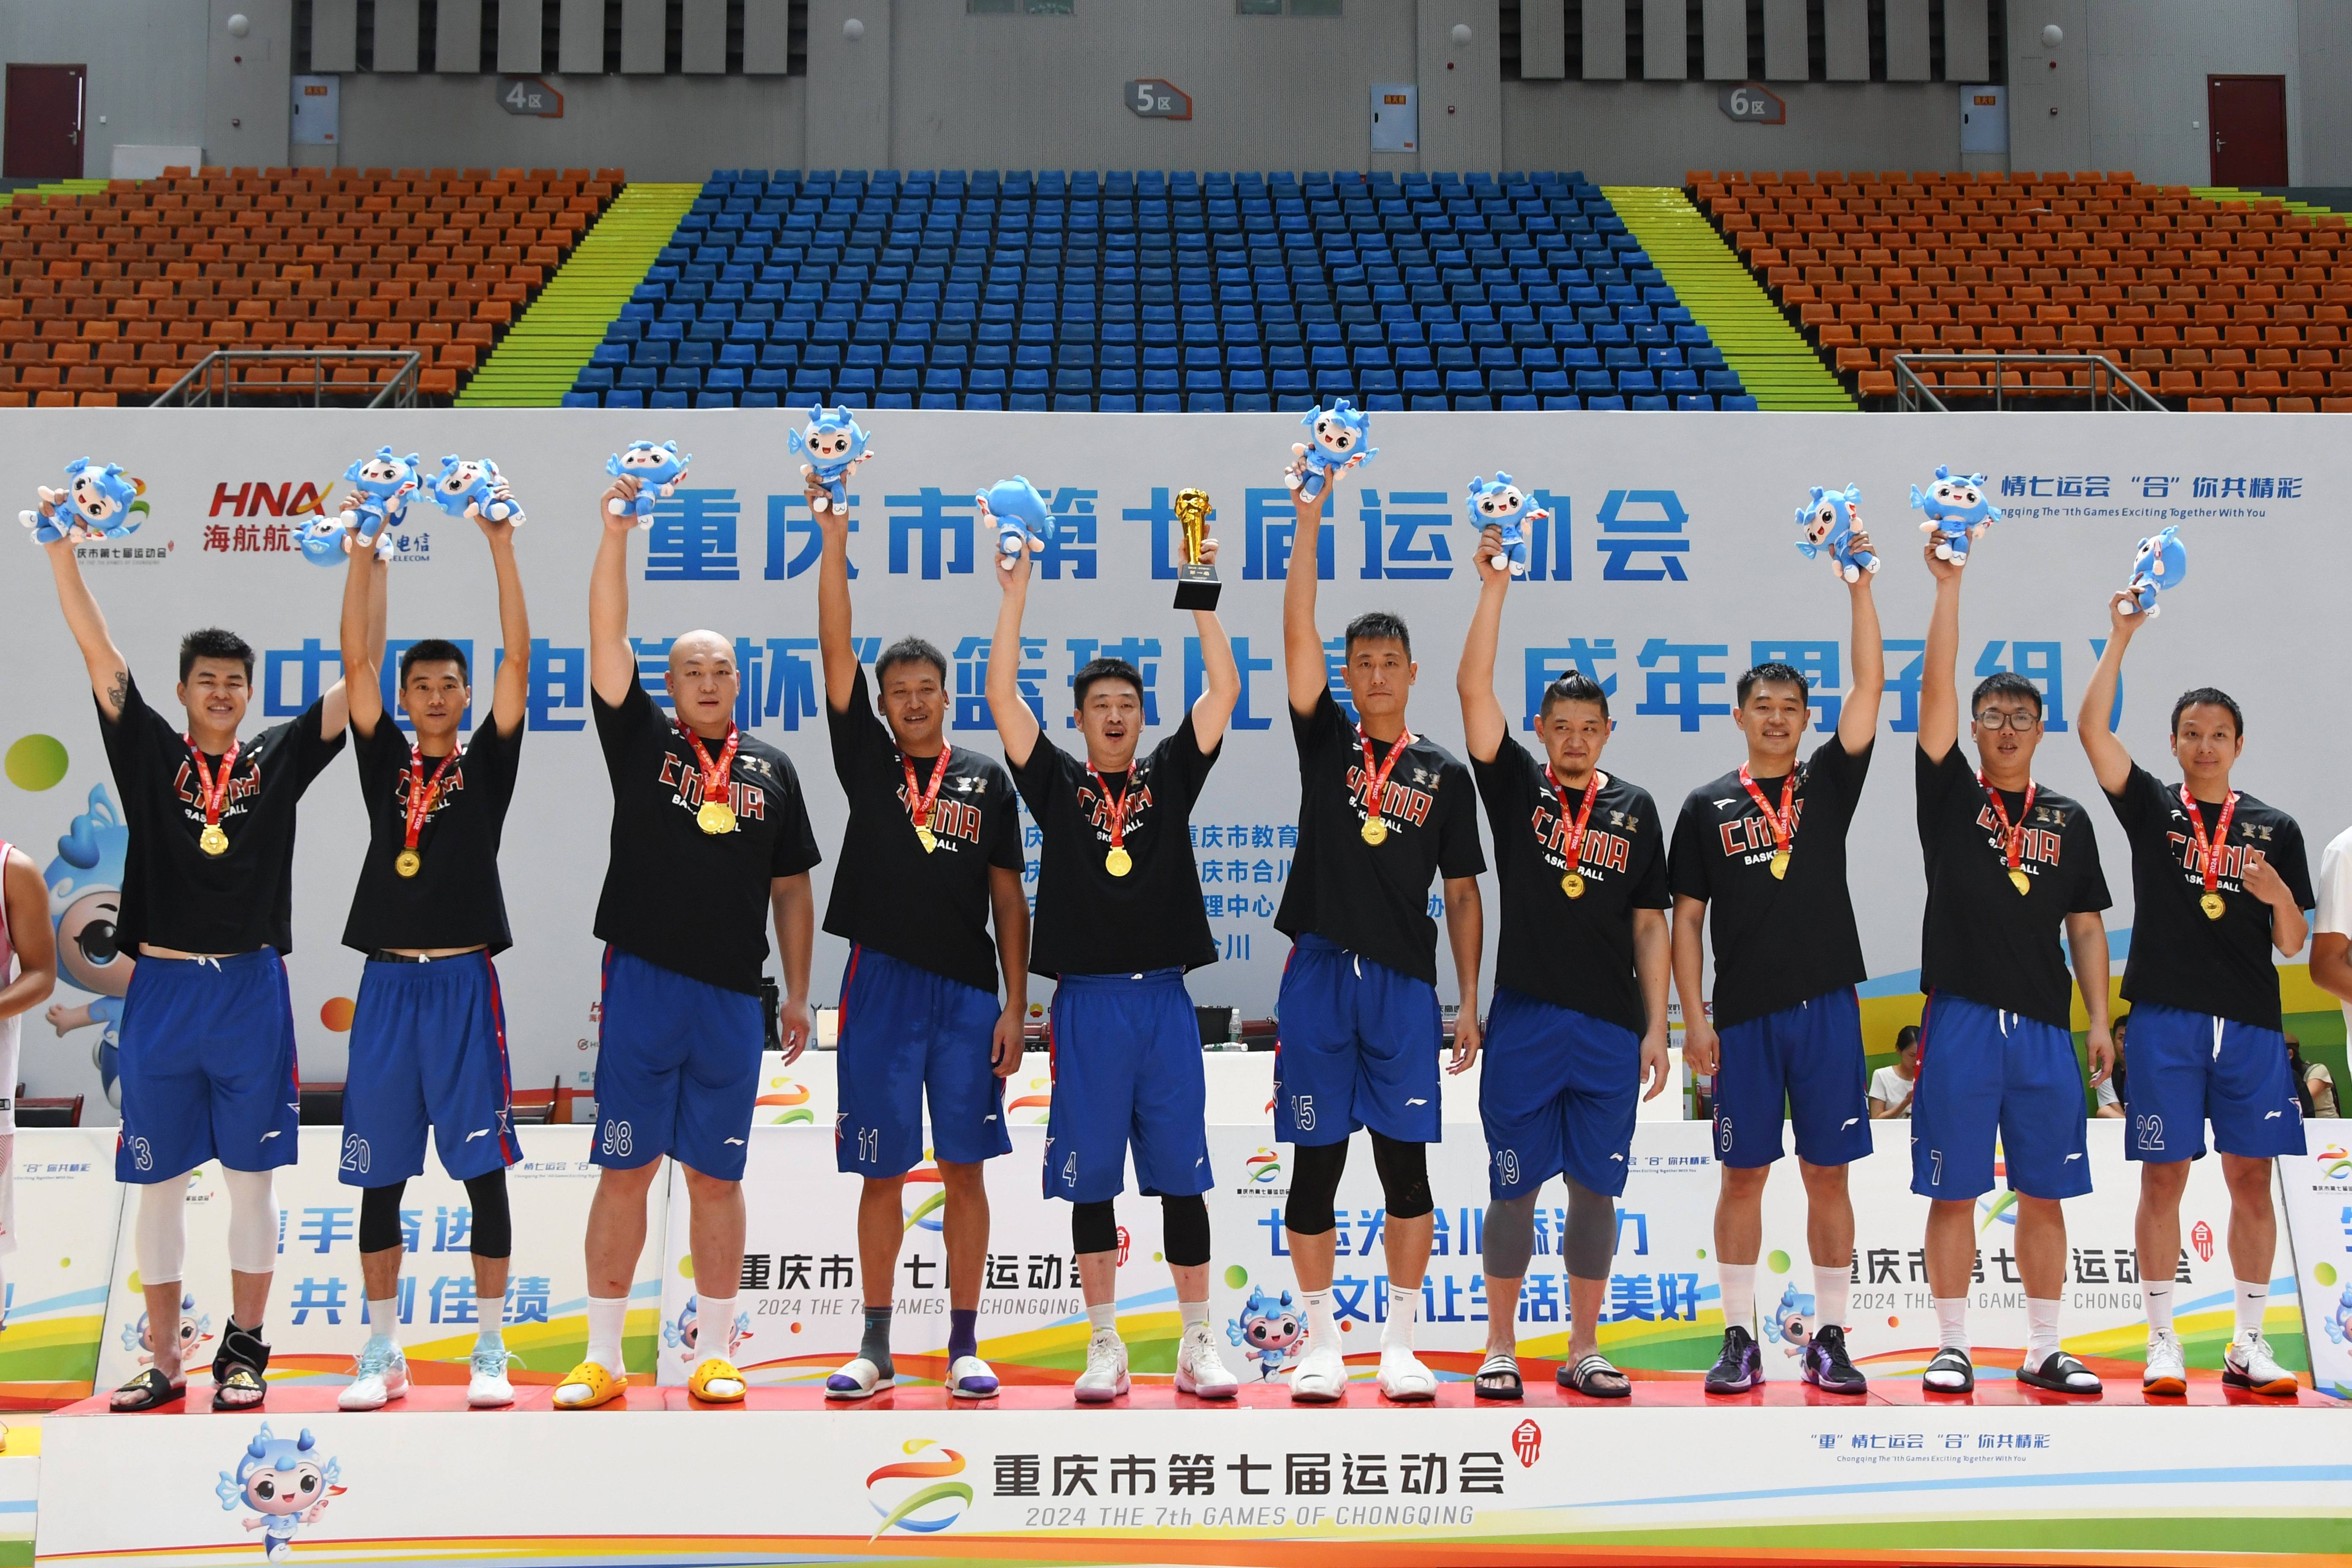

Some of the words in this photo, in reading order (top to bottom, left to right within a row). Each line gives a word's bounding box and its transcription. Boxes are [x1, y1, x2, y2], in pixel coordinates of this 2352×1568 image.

[506, 82, 542, 108] 4区
[1138, 84, 1171, 111] 5区
[1731, 88, 1765, 114] 6区
[208, 482, 330, 517] HNA
[2001, 507, 2039, 519] ngqing
[2042, 507, 2060, 516] The
[2084, 508, 2119, 516] Games
[2122, 508, 2167, 519] Exciting
[2170, 508, 2217, 519] Together
[2219, 508, 2244, 517] With
[2246, 509, 2265, 517] You
[74, 548, 166, 558] 庆市第七届运动会
[203, 524, 302, 553] 海航航
[1291, 1095, 1316, 1131] 15
[602, 1119, 633, 1157] 98
[858, 1127, 879, 1164] 11
[1720, 1116, 1733, 1153] 6
[2137, 1114, 2165, 1151] 22
[128, 1135, 153, 1171] 13
[340, 1133, 371, 1174] 20
[1062, 1151, 1077, 1187] 4
[1496, 1149, 1520, 1186] 19
[1930, 1149, 1942, 1186] 7
[757, 1299, 801, 1315] 2024
[811, 1299, 844, 1315] THE
[980, 1298, 1079, 1315] CHONGQING
[1853, 1293, 1895, 1309] 2024
[1979, 1293, 2026, 1309] GAME
[2074, 1293, 2142, 1311] CHONGQ
[994, 1452, 1504, 1496] 重庆市第七届运动会
[1837, 1456, 1877, 1464] Chongqing
[1931, 1456, 1961, 1464] Exciting
[1963, 1456, 1994, 1464] Together
[1026, 1508, 1086, 1526] 2024
[1100, 1507, 1144, 1526] THE
[1156, 1507, 1192, 1526] 7th
[1202, 1506, 1285, 1526] GAMES
[1297, 1506, 1327, 1525] OF
[1336, 1505, 1474, 1526] CHONGQING
